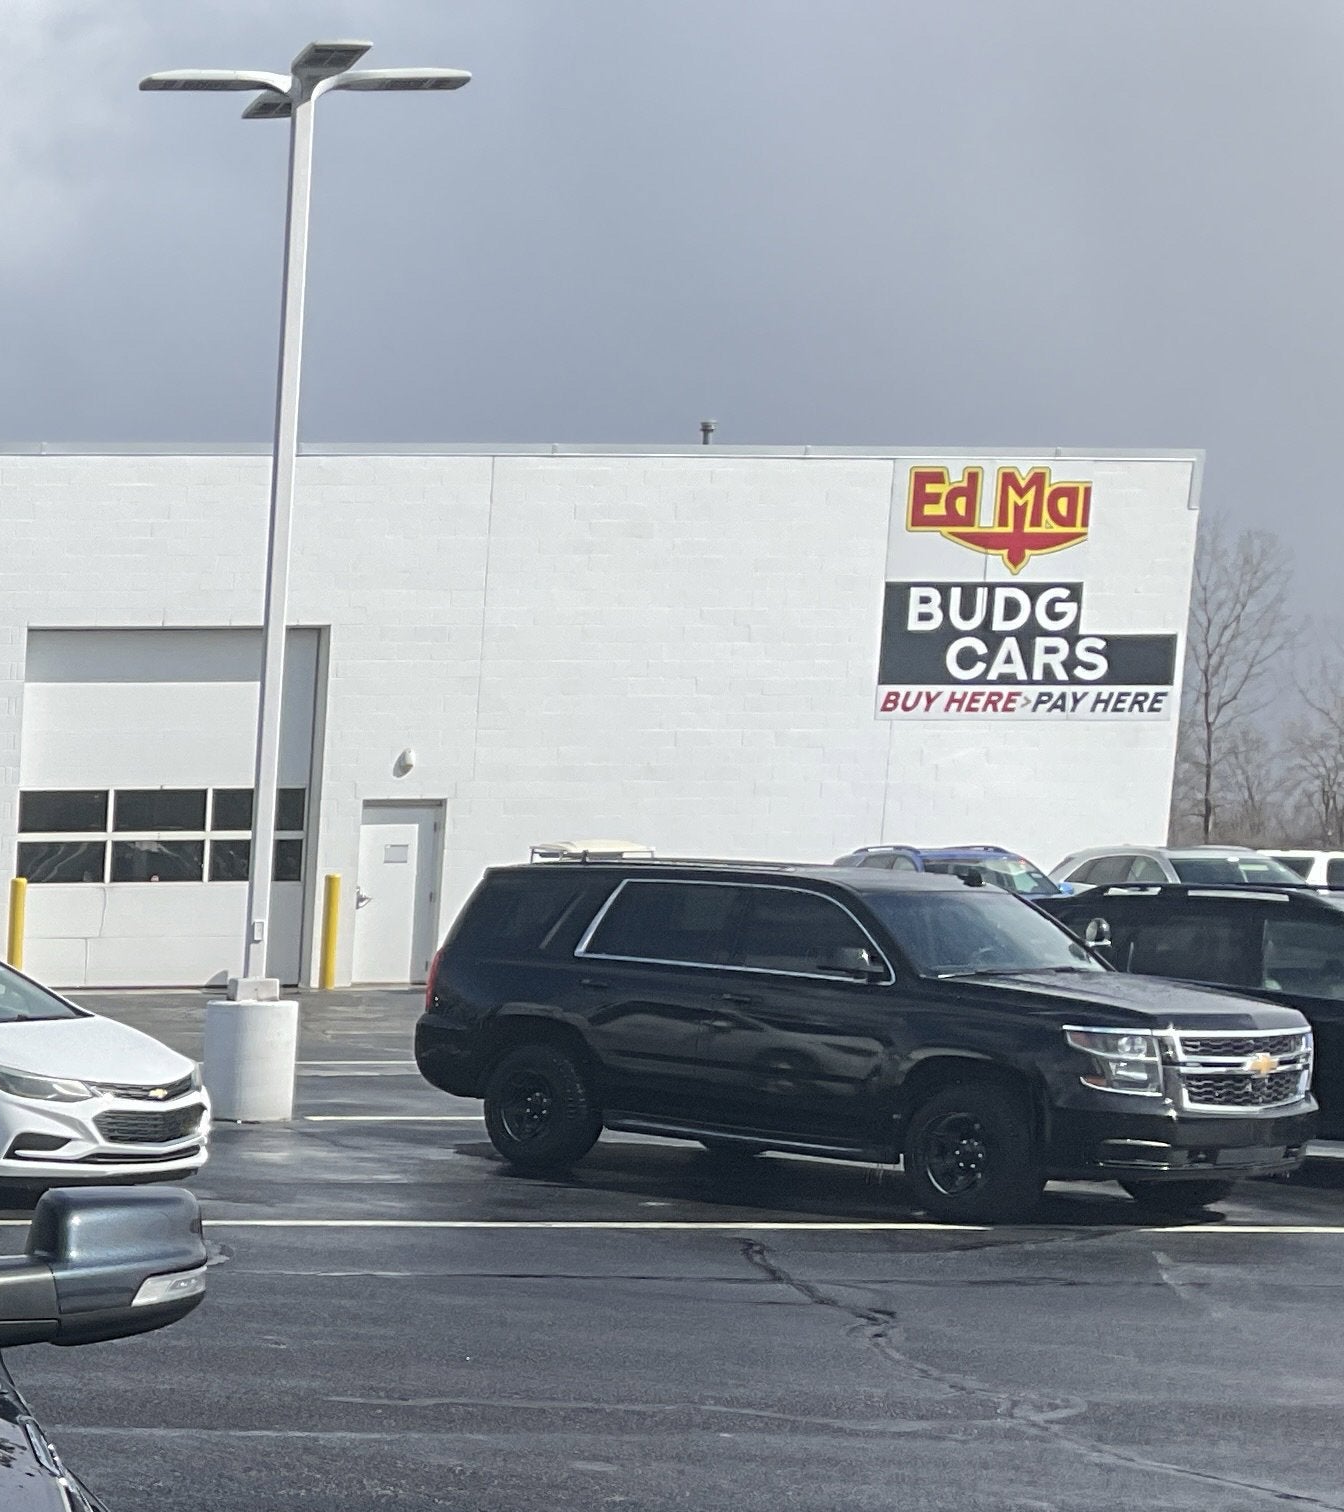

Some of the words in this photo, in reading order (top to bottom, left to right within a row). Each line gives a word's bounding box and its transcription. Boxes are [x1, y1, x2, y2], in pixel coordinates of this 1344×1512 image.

[909, 468, 981, 529] Ed
[907, 586, 1078, 632] BUDG
[945, 635, 1109, 681] CARS
[880, 690, 943, 713] BUY
[943, 690, 1023, 713] HERE
[1031, 690, 1089, 713] PAY
[1090, 690, 1168, 713] HERE
